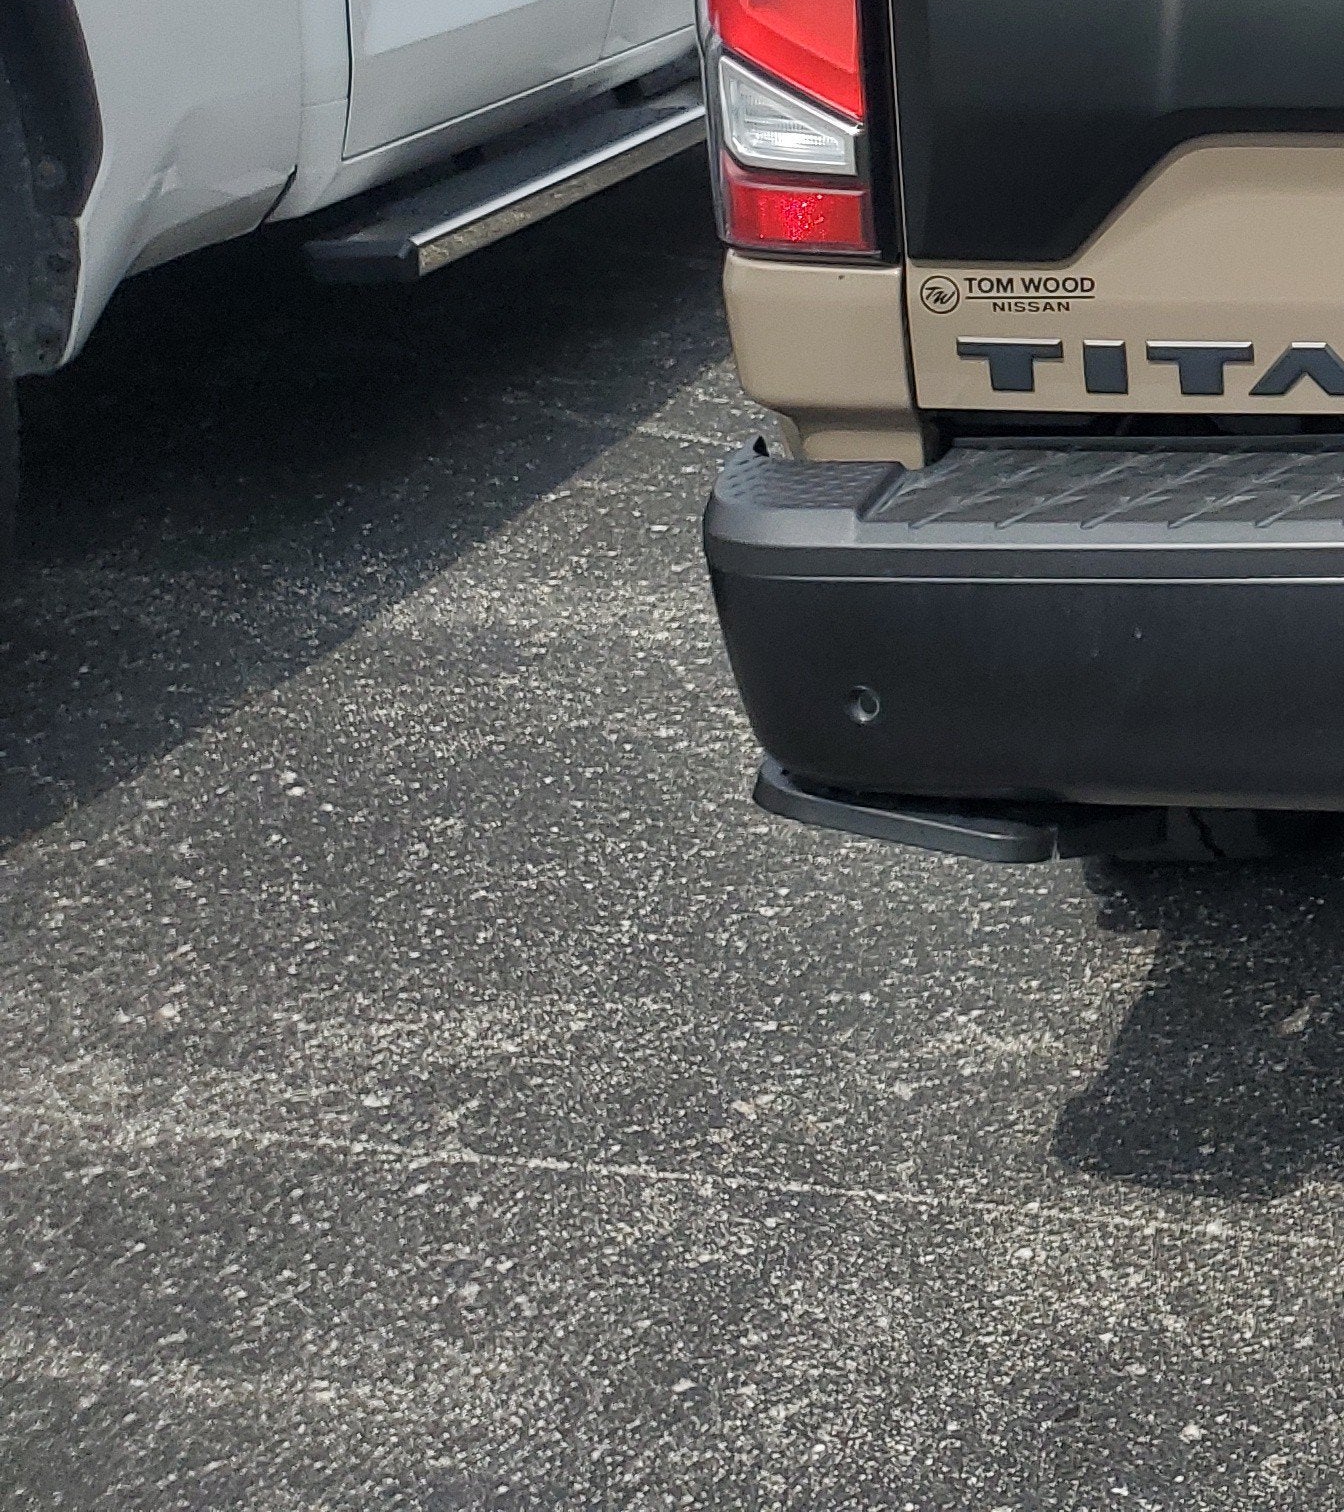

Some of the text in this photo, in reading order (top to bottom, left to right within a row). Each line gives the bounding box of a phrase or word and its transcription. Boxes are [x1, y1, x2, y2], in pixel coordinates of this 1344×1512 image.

[963, 277, 1096, 294] TOM WOOD
[992, 301, 1071, 313] NISSAN
